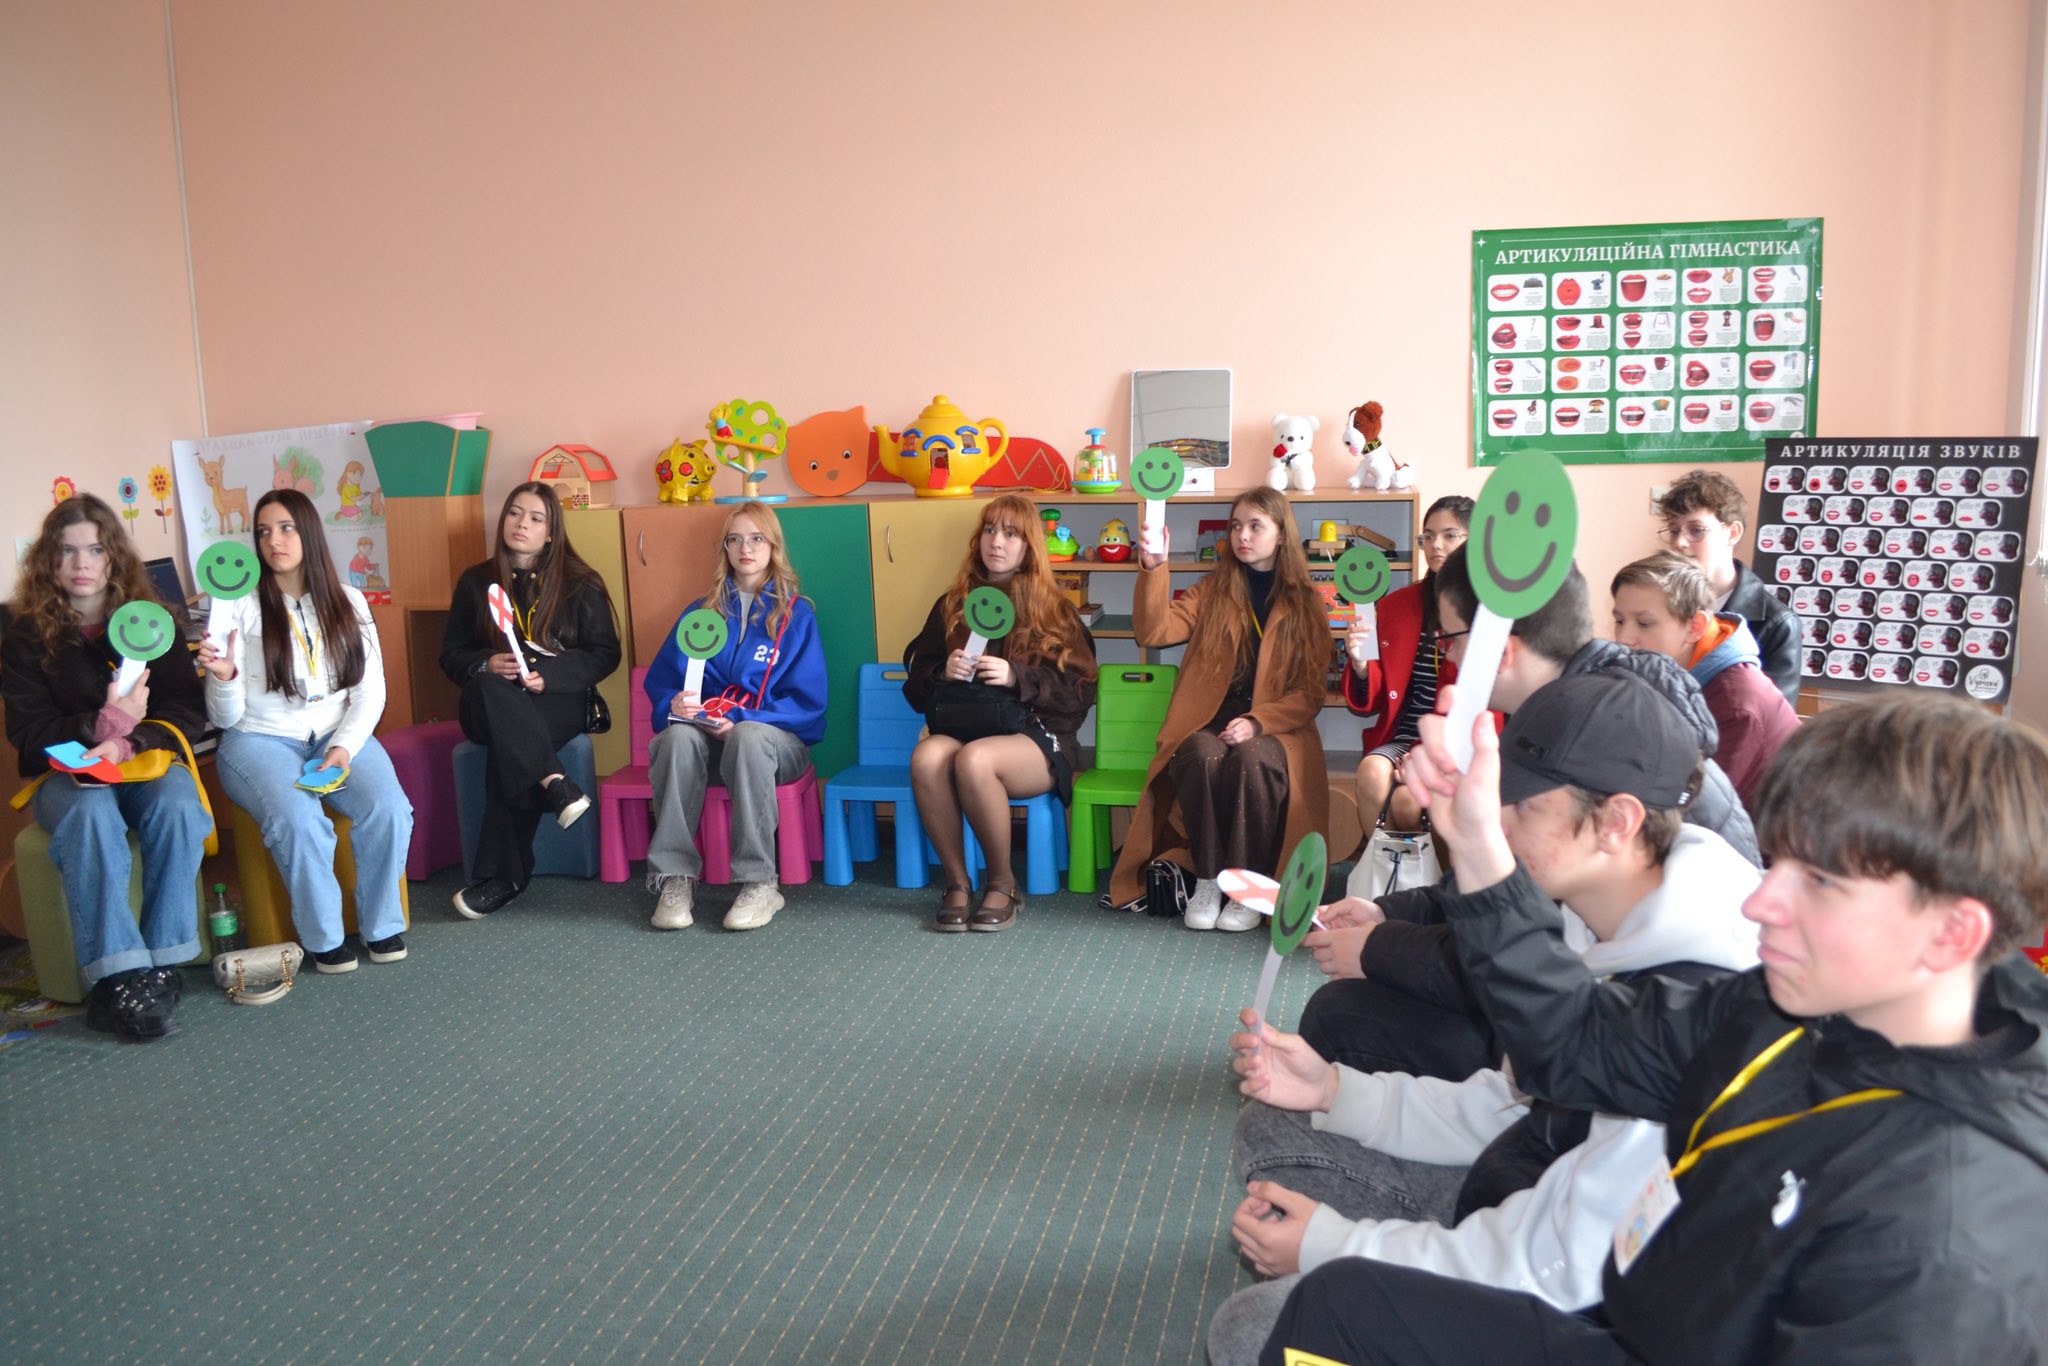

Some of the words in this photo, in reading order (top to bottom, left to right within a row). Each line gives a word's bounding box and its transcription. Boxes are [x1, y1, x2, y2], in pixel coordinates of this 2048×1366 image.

[1495, 242, 1664, 264] АРТИКУЛЯЦІЙНА
[1669, 240, 1801, 259] ГІМНАСТИКА
[1780, 445, 1930, 460] АРТИКУЛЯЦІЯ
[1940, 445, 2021, 458] ЗВУКІВ
